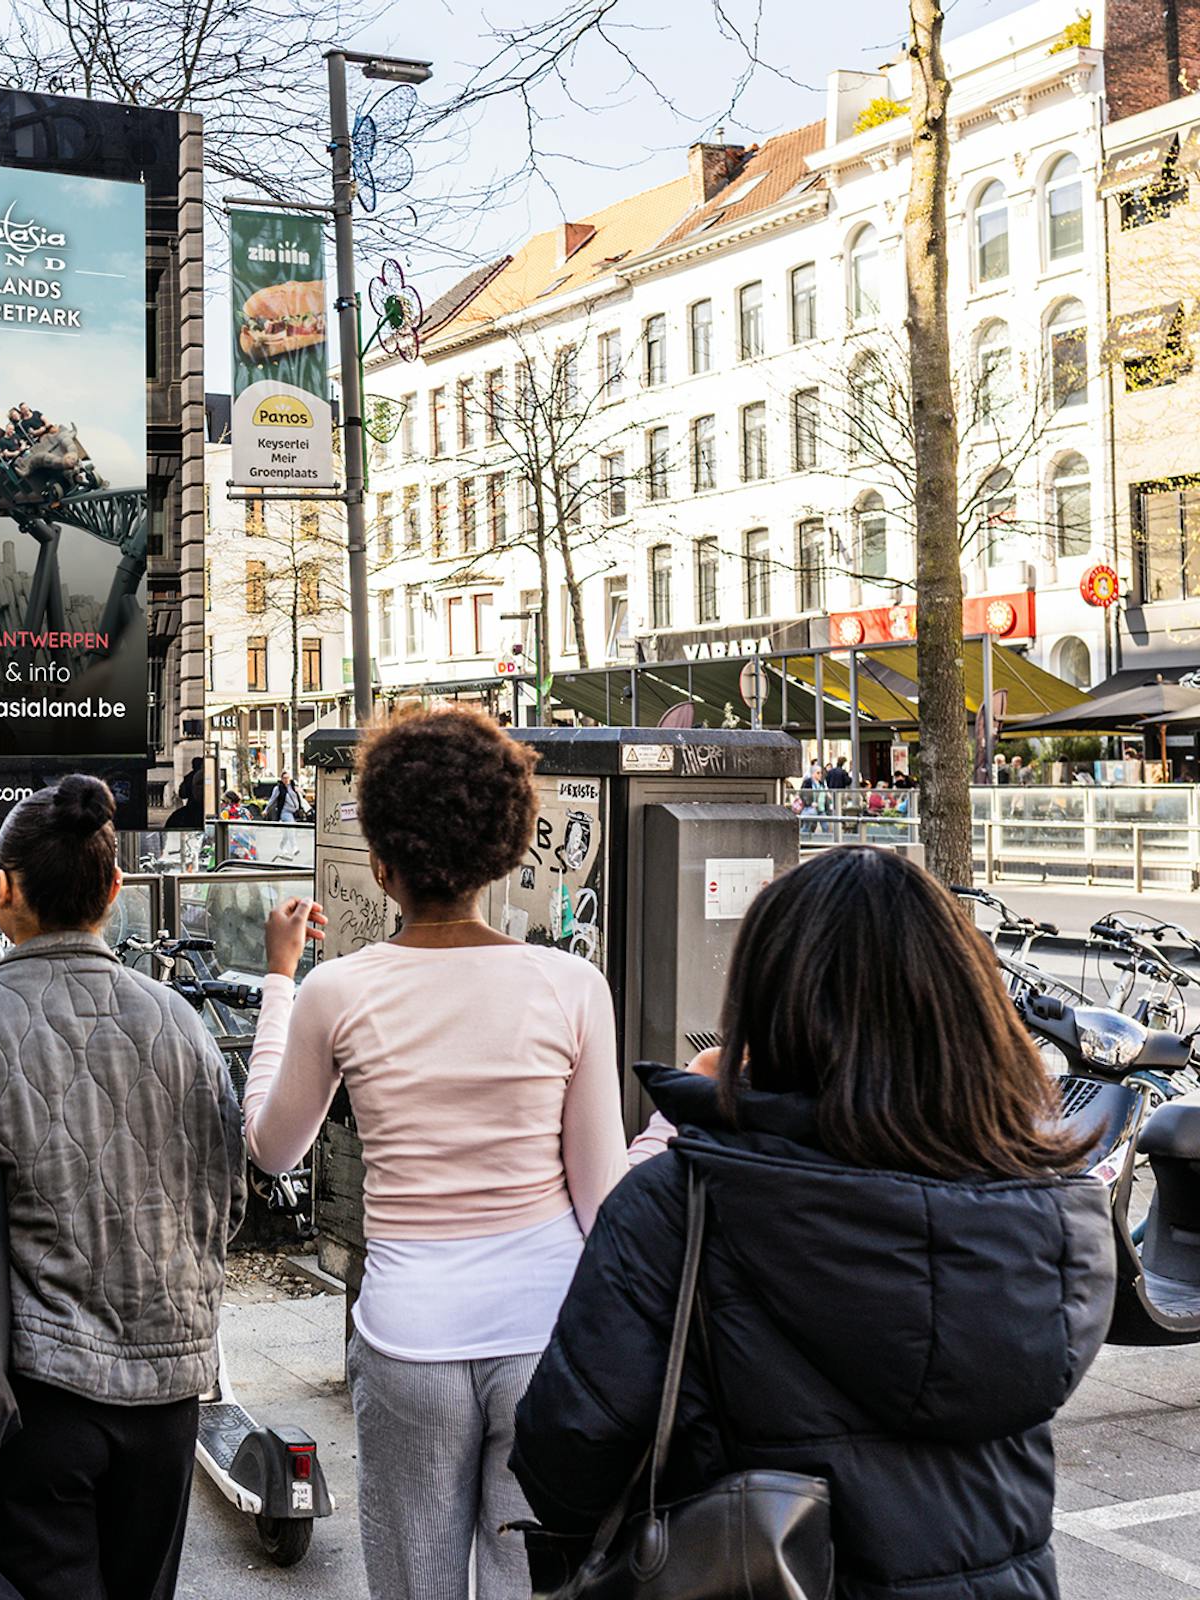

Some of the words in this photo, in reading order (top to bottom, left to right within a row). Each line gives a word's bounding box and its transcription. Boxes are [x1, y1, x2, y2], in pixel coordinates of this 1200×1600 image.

[248, 244, 276, 262] zin
[260, 410, 308, 424] Panos
[258, 438, 309, 450] Keyserlei
[271, 453, 297, 463] Meir
[249, 467, 319, 479] Groenplaats
[5, 662, 23, 682] &
[29, 660, 71, 682] info
